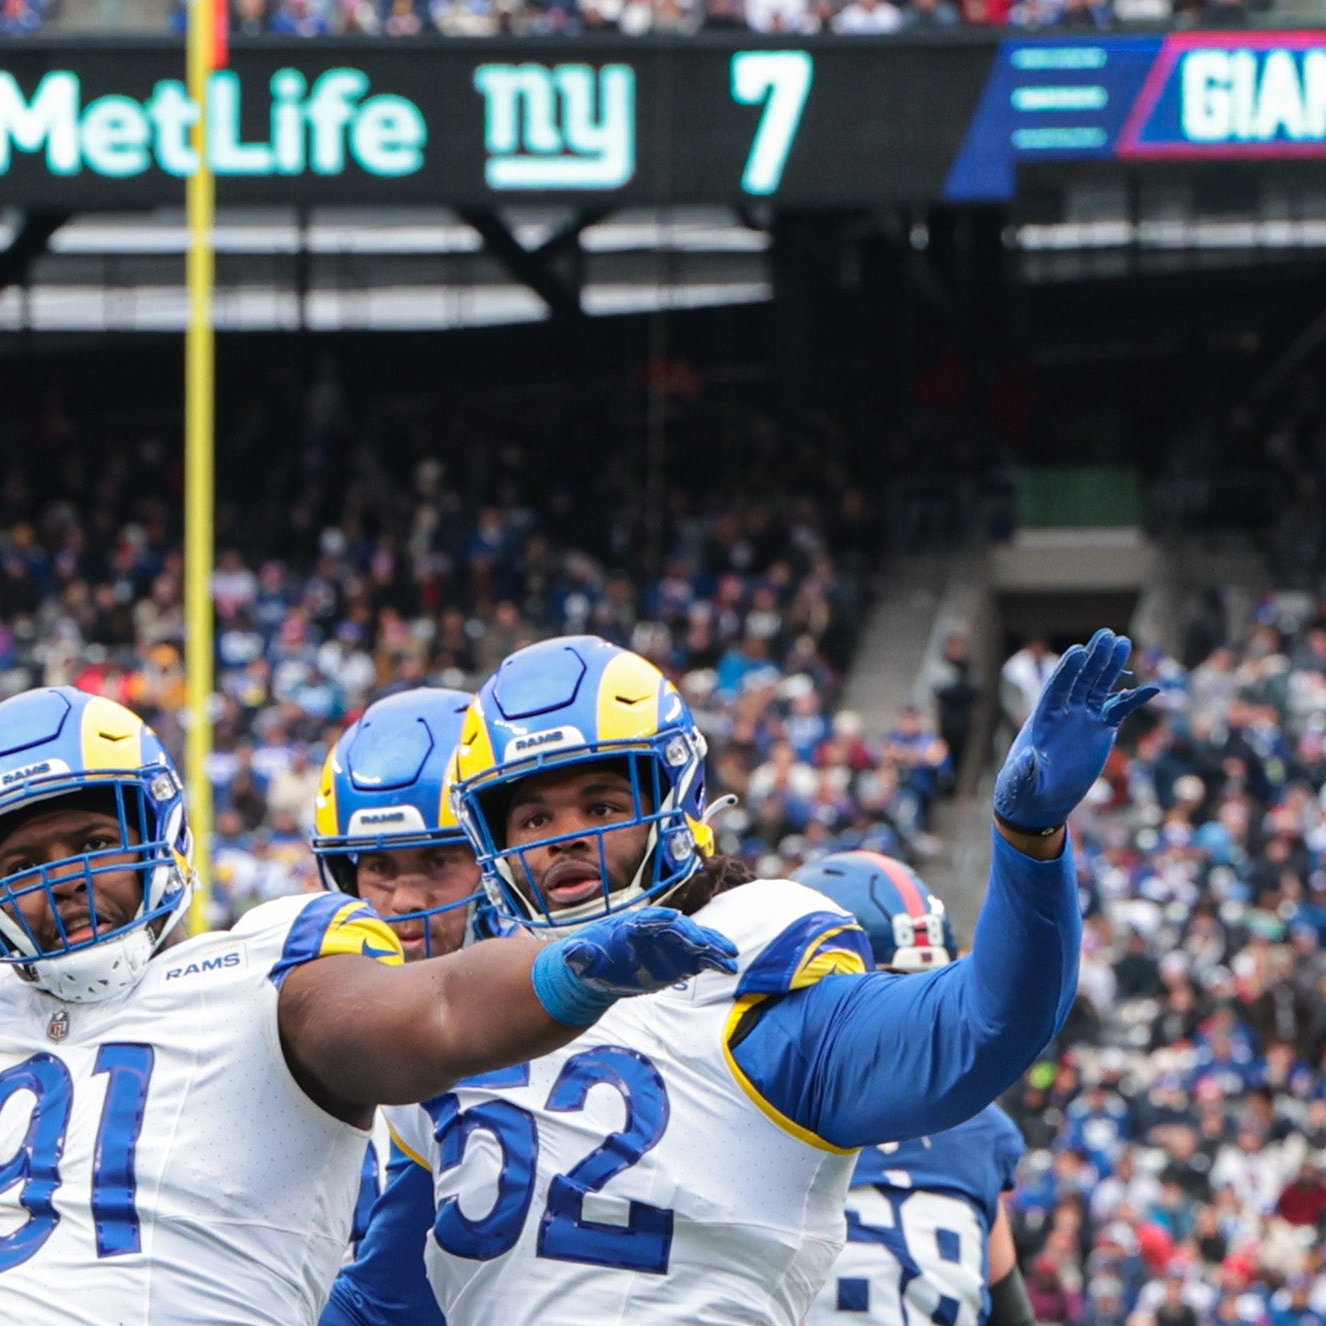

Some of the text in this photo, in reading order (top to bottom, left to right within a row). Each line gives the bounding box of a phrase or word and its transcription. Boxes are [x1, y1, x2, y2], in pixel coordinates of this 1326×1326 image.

[731, 50, 813, 195] 7
[2, 763, 51, 784] RAMS
[165, 952, 241, 981] RAMS
[421, 1044, 674, 1275] 52
